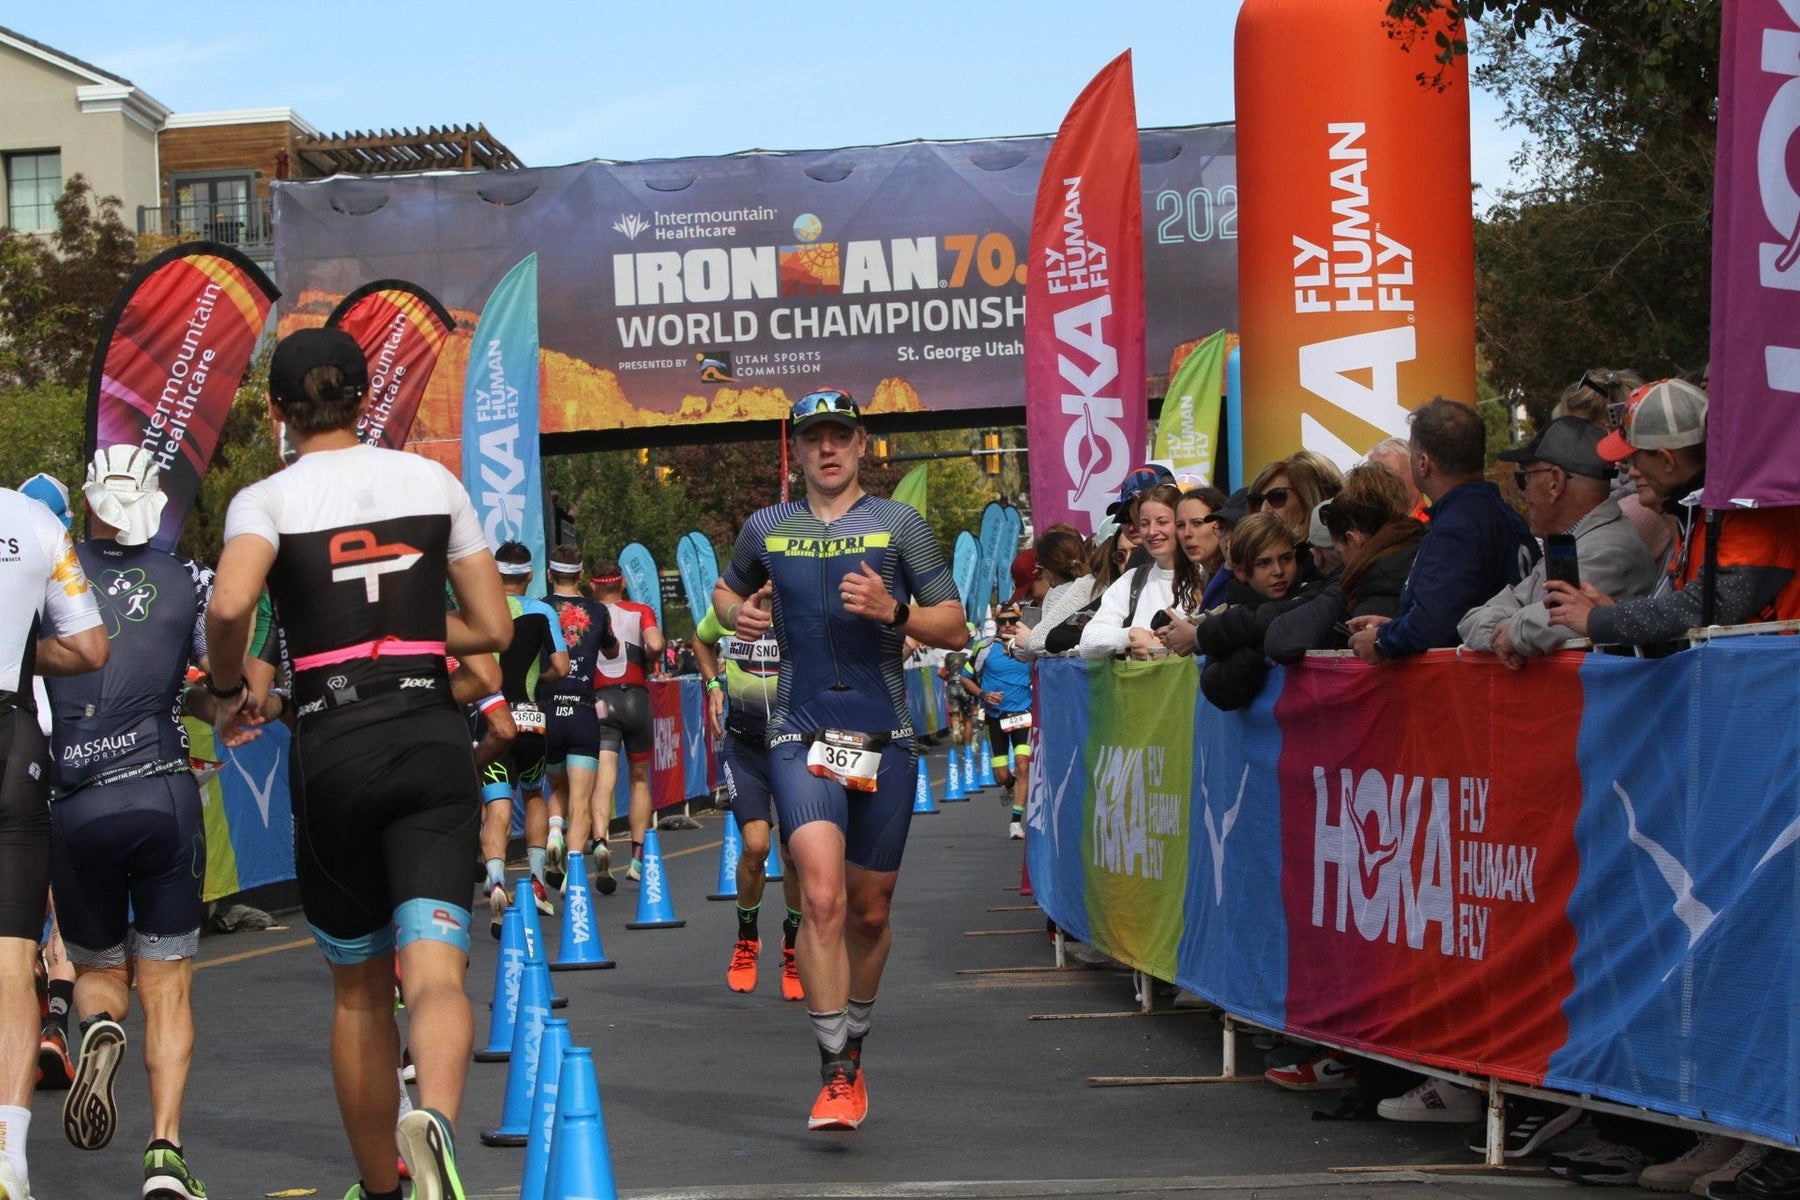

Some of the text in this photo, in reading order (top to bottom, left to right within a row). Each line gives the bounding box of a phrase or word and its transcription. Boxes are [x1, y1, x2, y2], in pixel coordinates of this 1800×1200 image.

[654, 206, 774, 226] Intermountain
[655, 225, 736, 240] Healthcare
[1063, 175, 1089, 291] HUMAN
[1327, 121, 1374, 312] HUMAN
[1045, 247, 1069, 294] FLY
[1086, 239, 1109, 289] FLY
[1293, 234, 1331, 314] FLY
[1375, 232, 1415, 312] FLY
[616, 311, 759, 349] WORLD
[897, 340, 1024, 362] St. George Utah
[488, 338, 507, 421] HUMAN
[618, 358, 688, 371] PRESENTED BY
[735, 351, 822, 366] UTAH SPORTS
[736, 363, 822, 377] COMMISSION
[156, 349, 216, 471] Healthcare
[365, 365, 407, 448] ealthcare
[476, 388, 492, 423] FLY
[506, 385, 519, 419] FLY
[786, 535, 865, 552] PLAYTRI
[556, 706, 574, 717] USA
[63, 732, 138, 760] DASSAULT
[74, 749, 126, 768] SPORTS
[826, 746, 862, 768] 367
[1093, 745, 1149, 879] HOKA
[1459, 776, 1489, 834] FLY
[644, 854, 662, 905] HOKA
[1312, 766, 1454, 956] HOKA
[1459, 840, 1536, 903] HUMAN
[569, 885, 590, 944] HOKA
[1457, 904, 1491, 960] FLY
